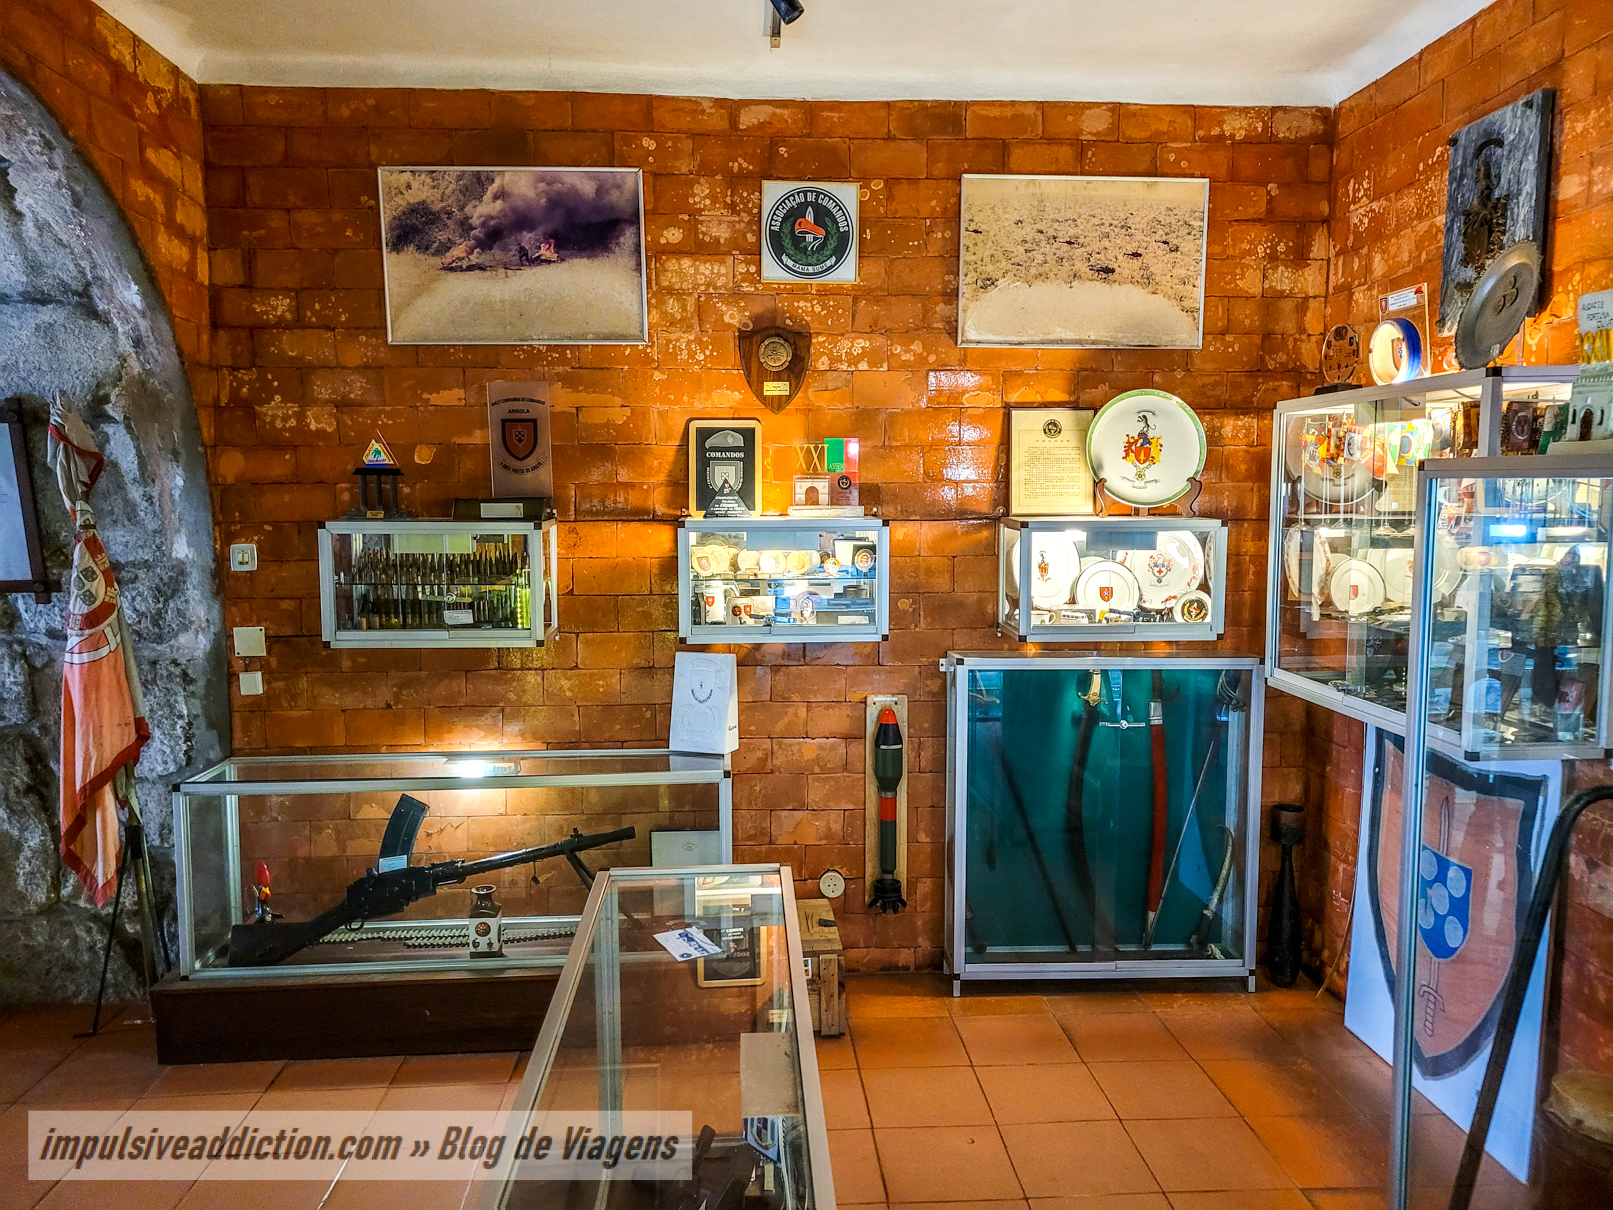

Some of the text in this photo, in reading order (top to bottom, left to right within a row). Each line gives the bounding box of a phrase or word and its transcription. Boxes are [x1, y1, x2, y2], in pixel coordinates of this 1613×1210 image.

[771, 192, 849, 232] ASSOCIAÇÃO DE COMANDOS
[792, 263, 810, 272] MAMA
[795, 443, 829, 473] XXI
